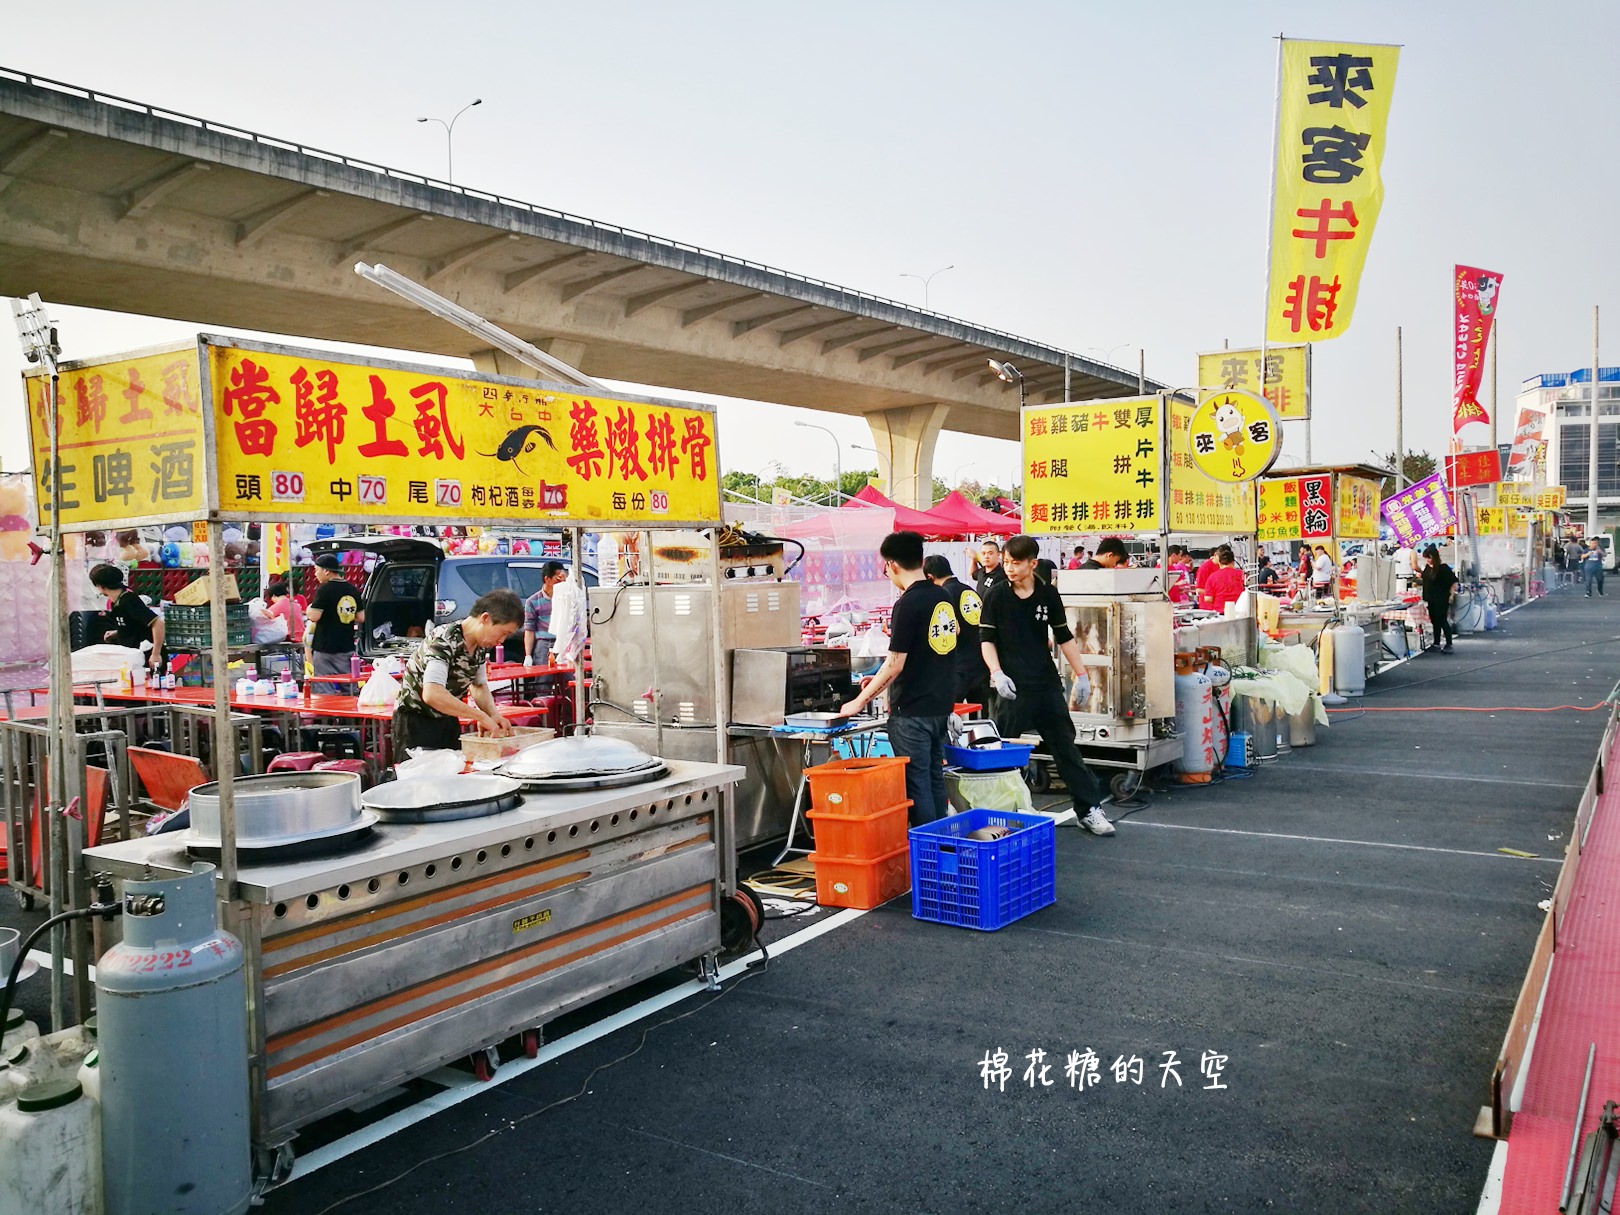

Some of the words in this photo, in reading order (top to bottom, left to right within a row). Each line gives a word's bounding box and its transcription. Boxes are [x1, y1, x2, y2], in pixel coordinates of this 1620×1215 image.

[223, 358, 465, 465] 當歸土虱
[566, 400, 712, 482] 藥燉排骨
[41, 440, 196, 511] 生啤酒
[235, 474, 262, 500] 頭
[275, 474, 303, 495] 80
[330, 477, 352, 502] 中
[361, 479, 385, 500] 70
[408, 480, 429, 503] 尾
[439, 484, 461, 503] 70
[612, 491, 645, 511] 每份
[652, 494, 668, 510] 80
[1304, 480, 1329, 533] 黑輪
